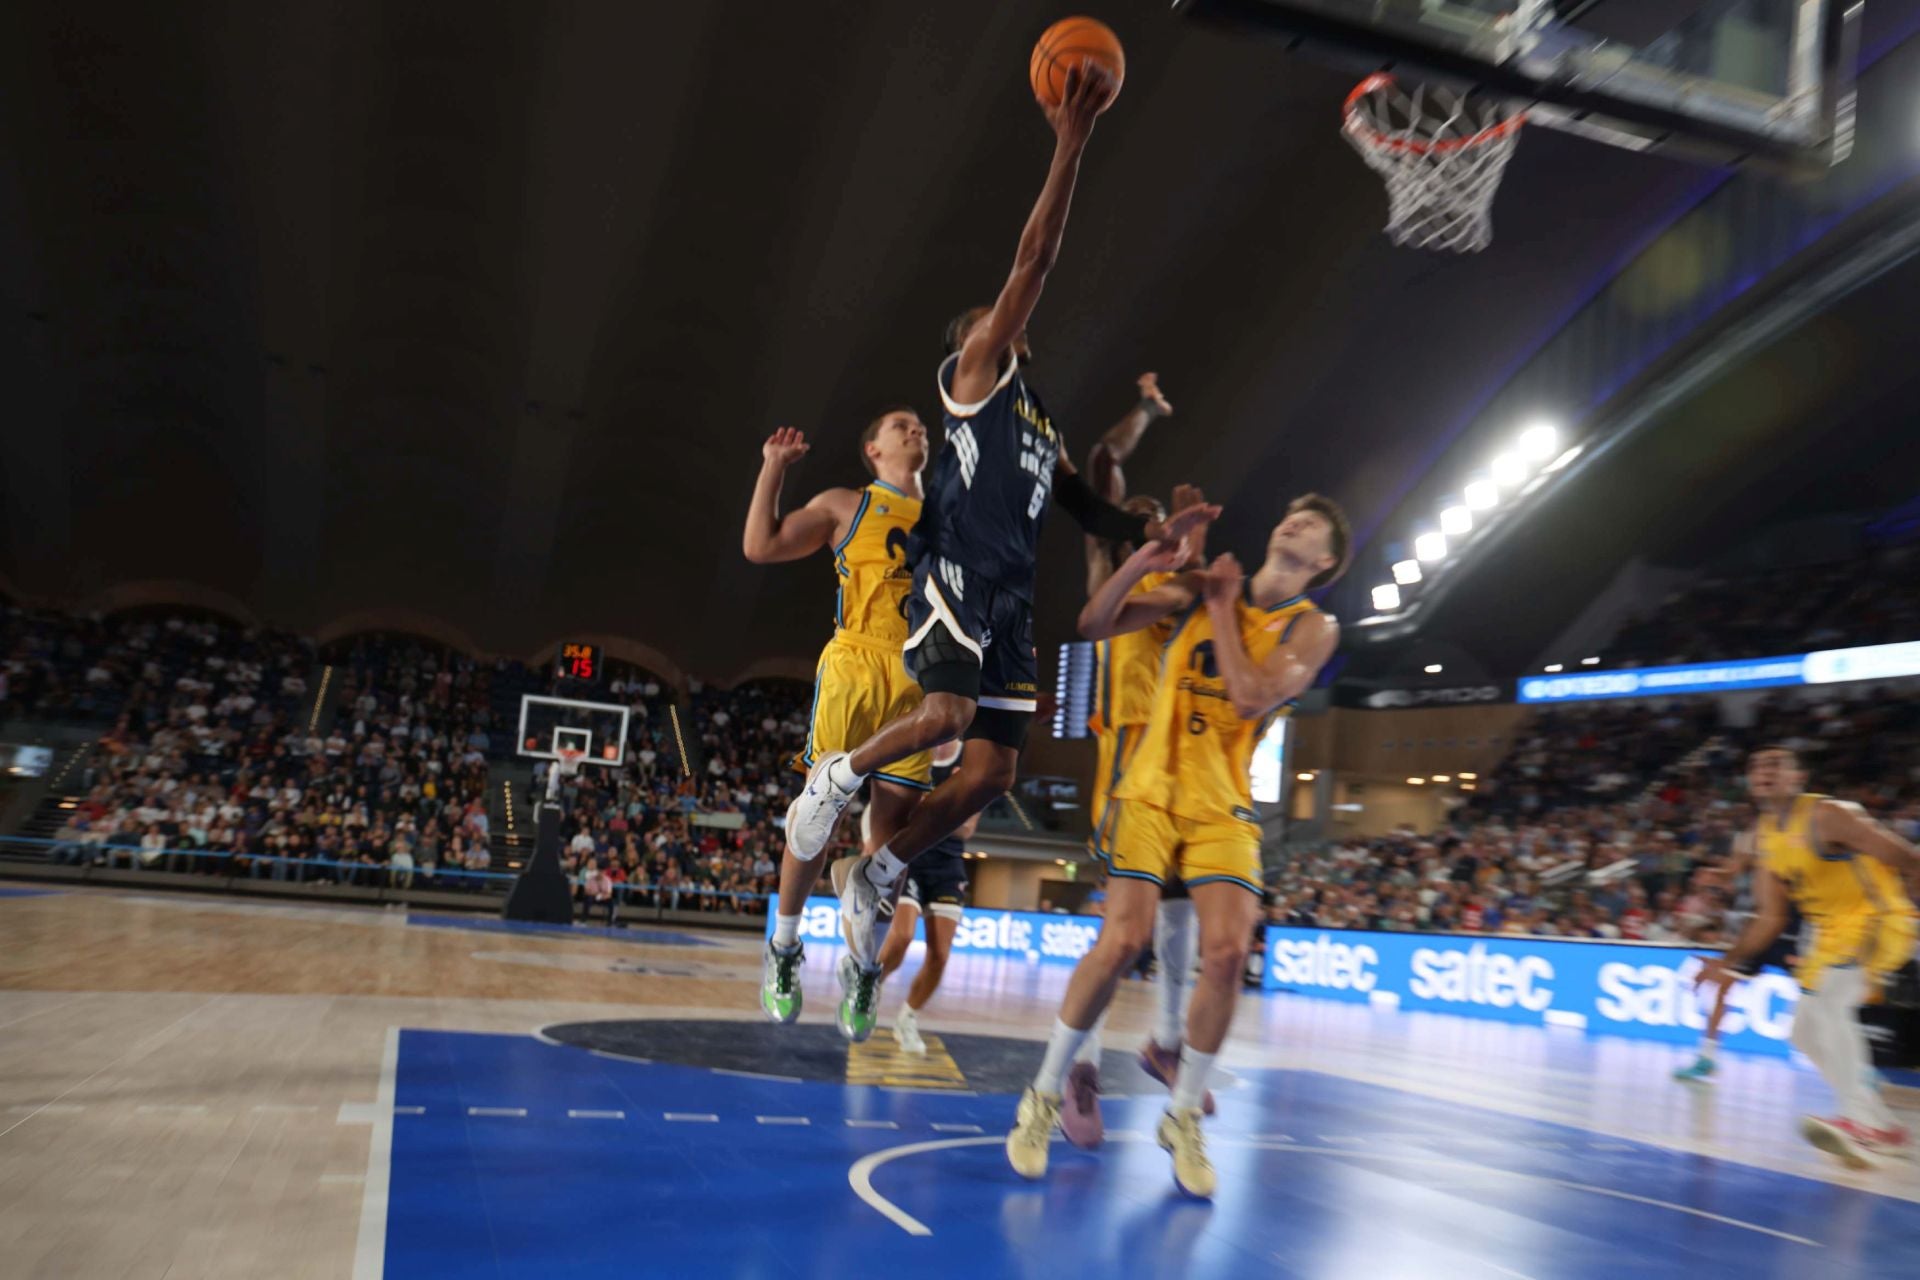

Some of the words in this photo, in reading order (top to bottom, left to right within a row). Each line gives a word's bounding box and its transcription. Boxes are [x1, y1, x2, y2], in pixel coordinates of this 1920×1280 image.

[572, 658, 593, 678] 15
[1271, 933, 1380, 992] satec
[1408, 941, 1555, 1012] satec
